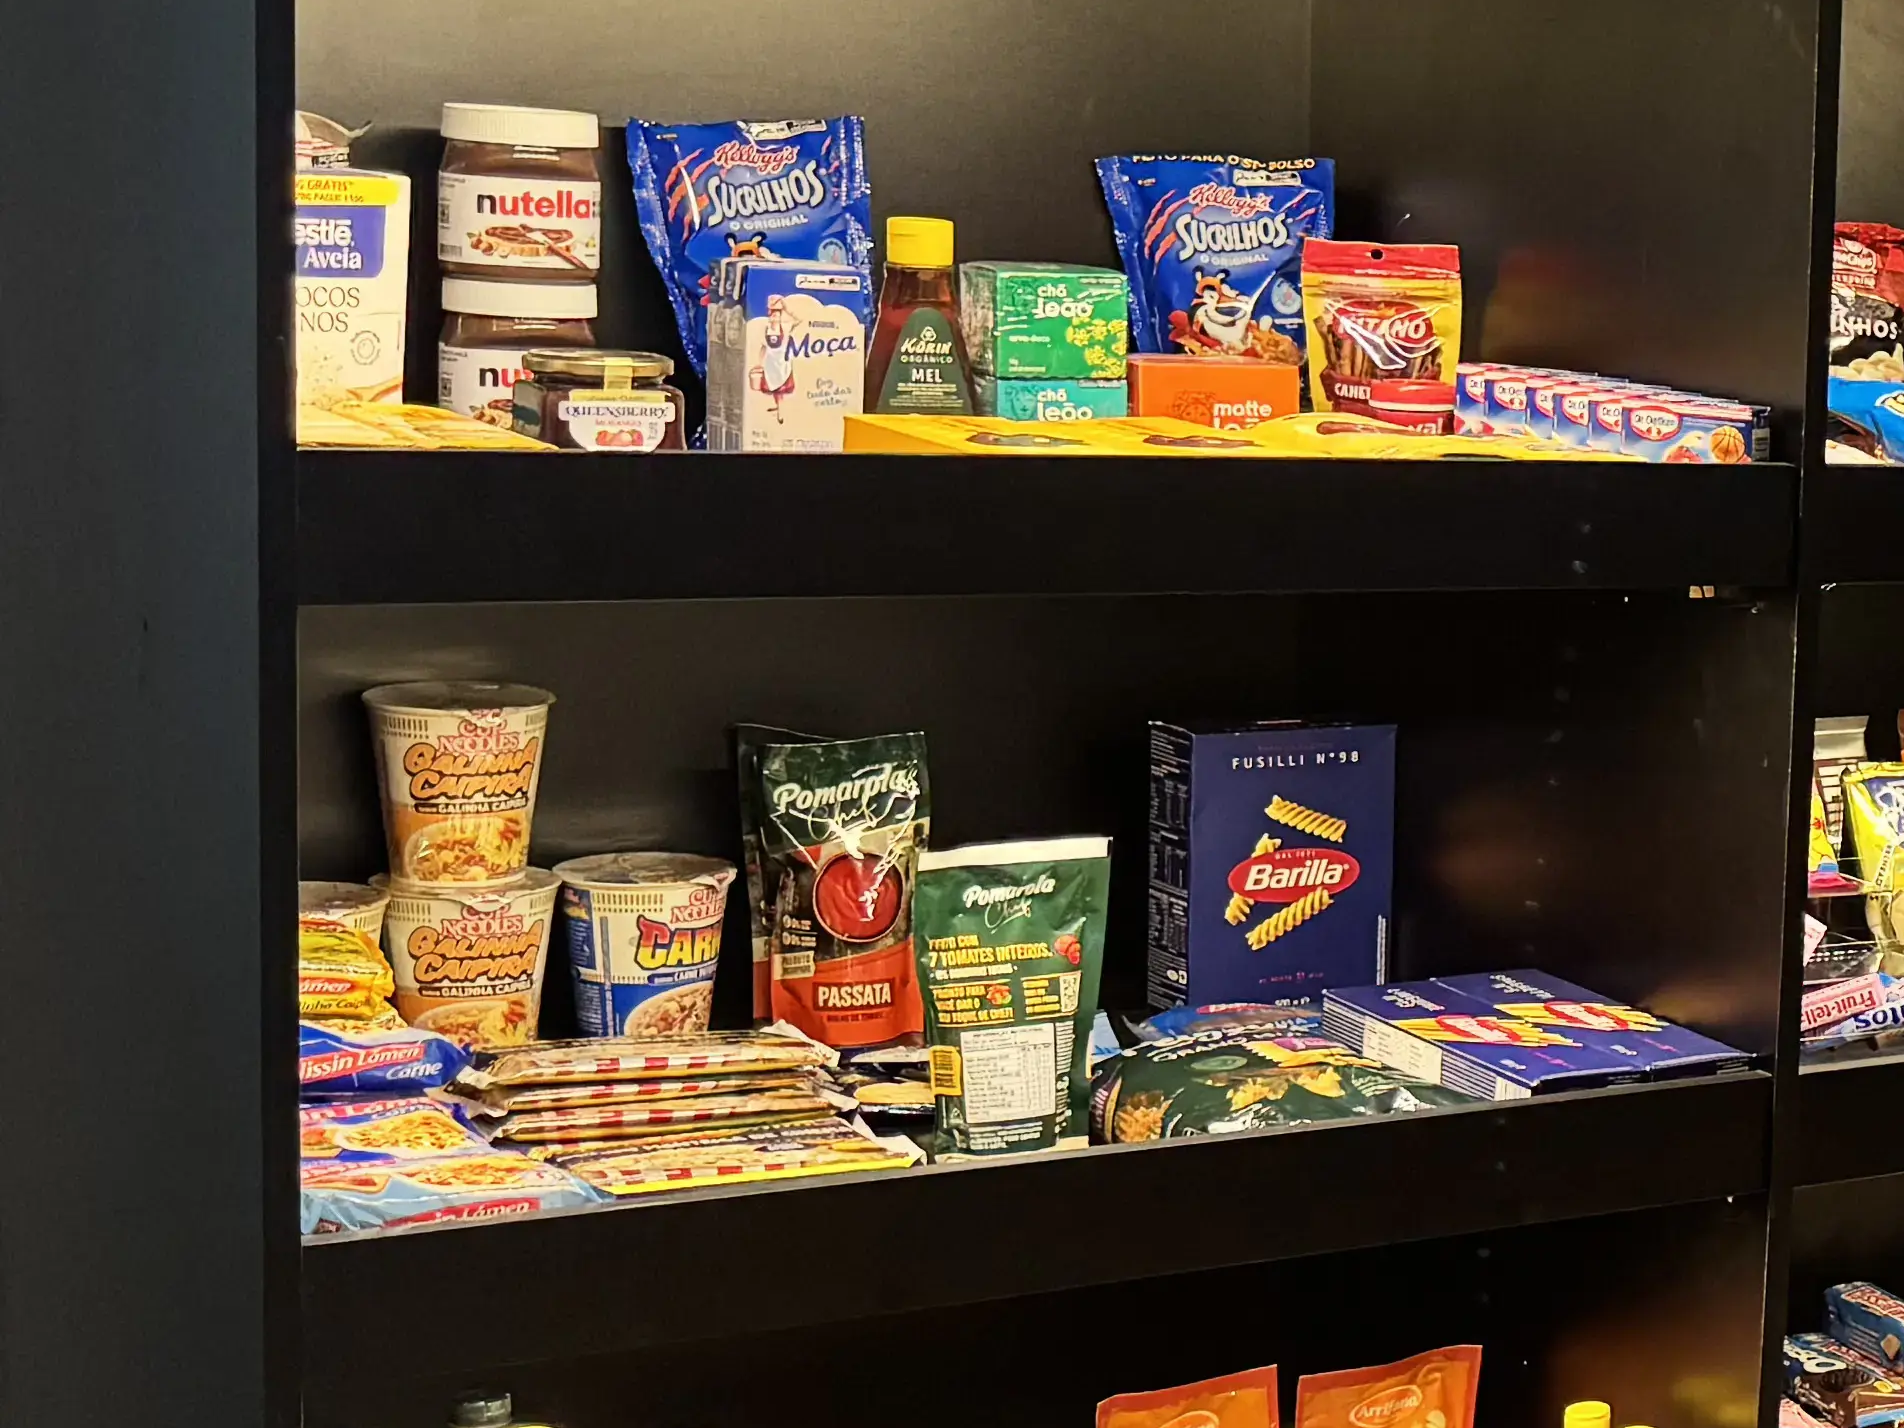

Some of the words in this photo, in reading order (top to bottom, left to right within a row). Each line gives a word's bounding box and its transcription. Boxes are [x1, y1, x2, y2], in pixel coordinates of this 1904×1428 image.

[714, 143, 800, 172] Kellogg's
[708, 161, 824, 225] SUCRILHOS
[1189, 182, 1274, 216] Kellogg's
[477, 191, 591, 219] nutella
[744, 214, 808, 231] ORIGINAL
[1175, 212, 1294, 261] SUCRILHOS
[1037, 284, 1067, 298] chá
[785, 333, 857, 362] Moça
[911, 368, 942, 383] MEL
[1037, 391, 1067, 403] chá
[564, 403, 670, 422] QUEENSBERRY
[1037, 403, 1093, 421] leão
[1213, 400, 1273, 418] matte
[437, 733, 519, 753] NOODLES
[1232, 754, 1306, 771] FUSILLI
[1243, 860, 1345, 893] Barilla
[963, 874, 1056, 908] Pomarola
[441, 915, 524, 936] NOODLES
[929, 952, 939, 967] 7
[941, 950, 994, 968] TOMATES
[817, 982, 893, 1007] PASSATA
[357, 1047, 421, 1066] Lámen
[386, 1062, 443, 1080] Carne
[1355, 1393, 1421, 1420] Arrifana
